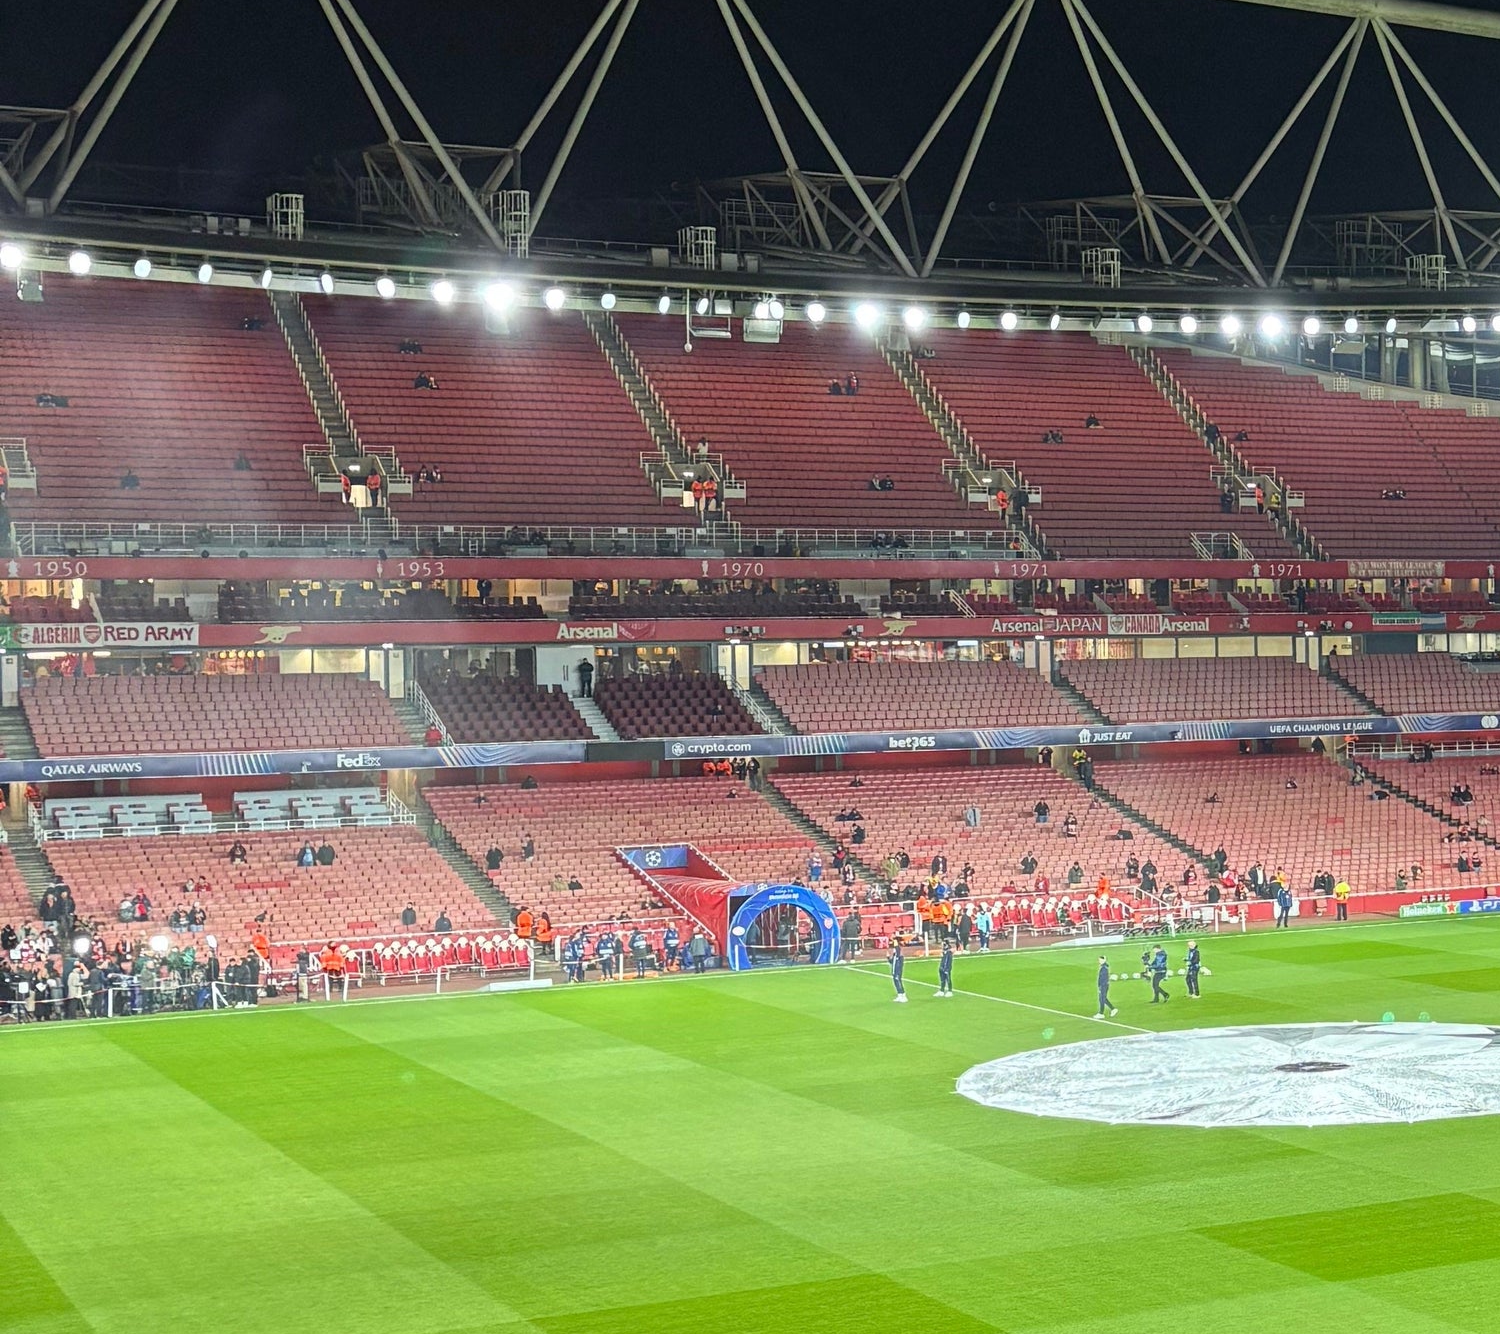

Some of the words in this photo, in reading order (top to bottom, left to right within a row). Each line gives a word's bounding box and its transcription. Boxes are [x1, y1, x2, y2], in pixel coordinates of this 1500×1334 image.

[33, 561, 87, 576] 1950
[398, 562, 445, 577] 1953
[722, 563, 764, 577] 1970
[1011, 563, 1048, 577] 1971
[1270, 563, 1302, 576] 1971
[556, 623, 618, 639] Arsenal
[992, 619, 1043, 632] Arsenal
[1053, 617, 1102, 632] JAPAN
[1124, 615, 1161, 633] CANADA
[1162, 617, 1209, 632] Arsenal
[32, 627, 81, 644] ALGERIA
[104, 626, 139, 641] RED
[145, 625, 194, 641] ARMY
[1269, 724, 1292, 734] UEFA
[1293, 723, 1341, 733] CHAMPIONS
[1343, 722, 1373, 731] LEAGUE
[889, 736, 936, 748] bet365
[1093, 732, 1114, 742] JUST
[1115, 731, 1133, 741] EAT
[687, 742, 751, 755] crypto.com
[336, 754, 381, 768] FedEx
[42, 764, 85, 776] QATAR
[87, 762, 142, 774] AIRWAYS
[1403, 906, 1443, 916] Heineken
